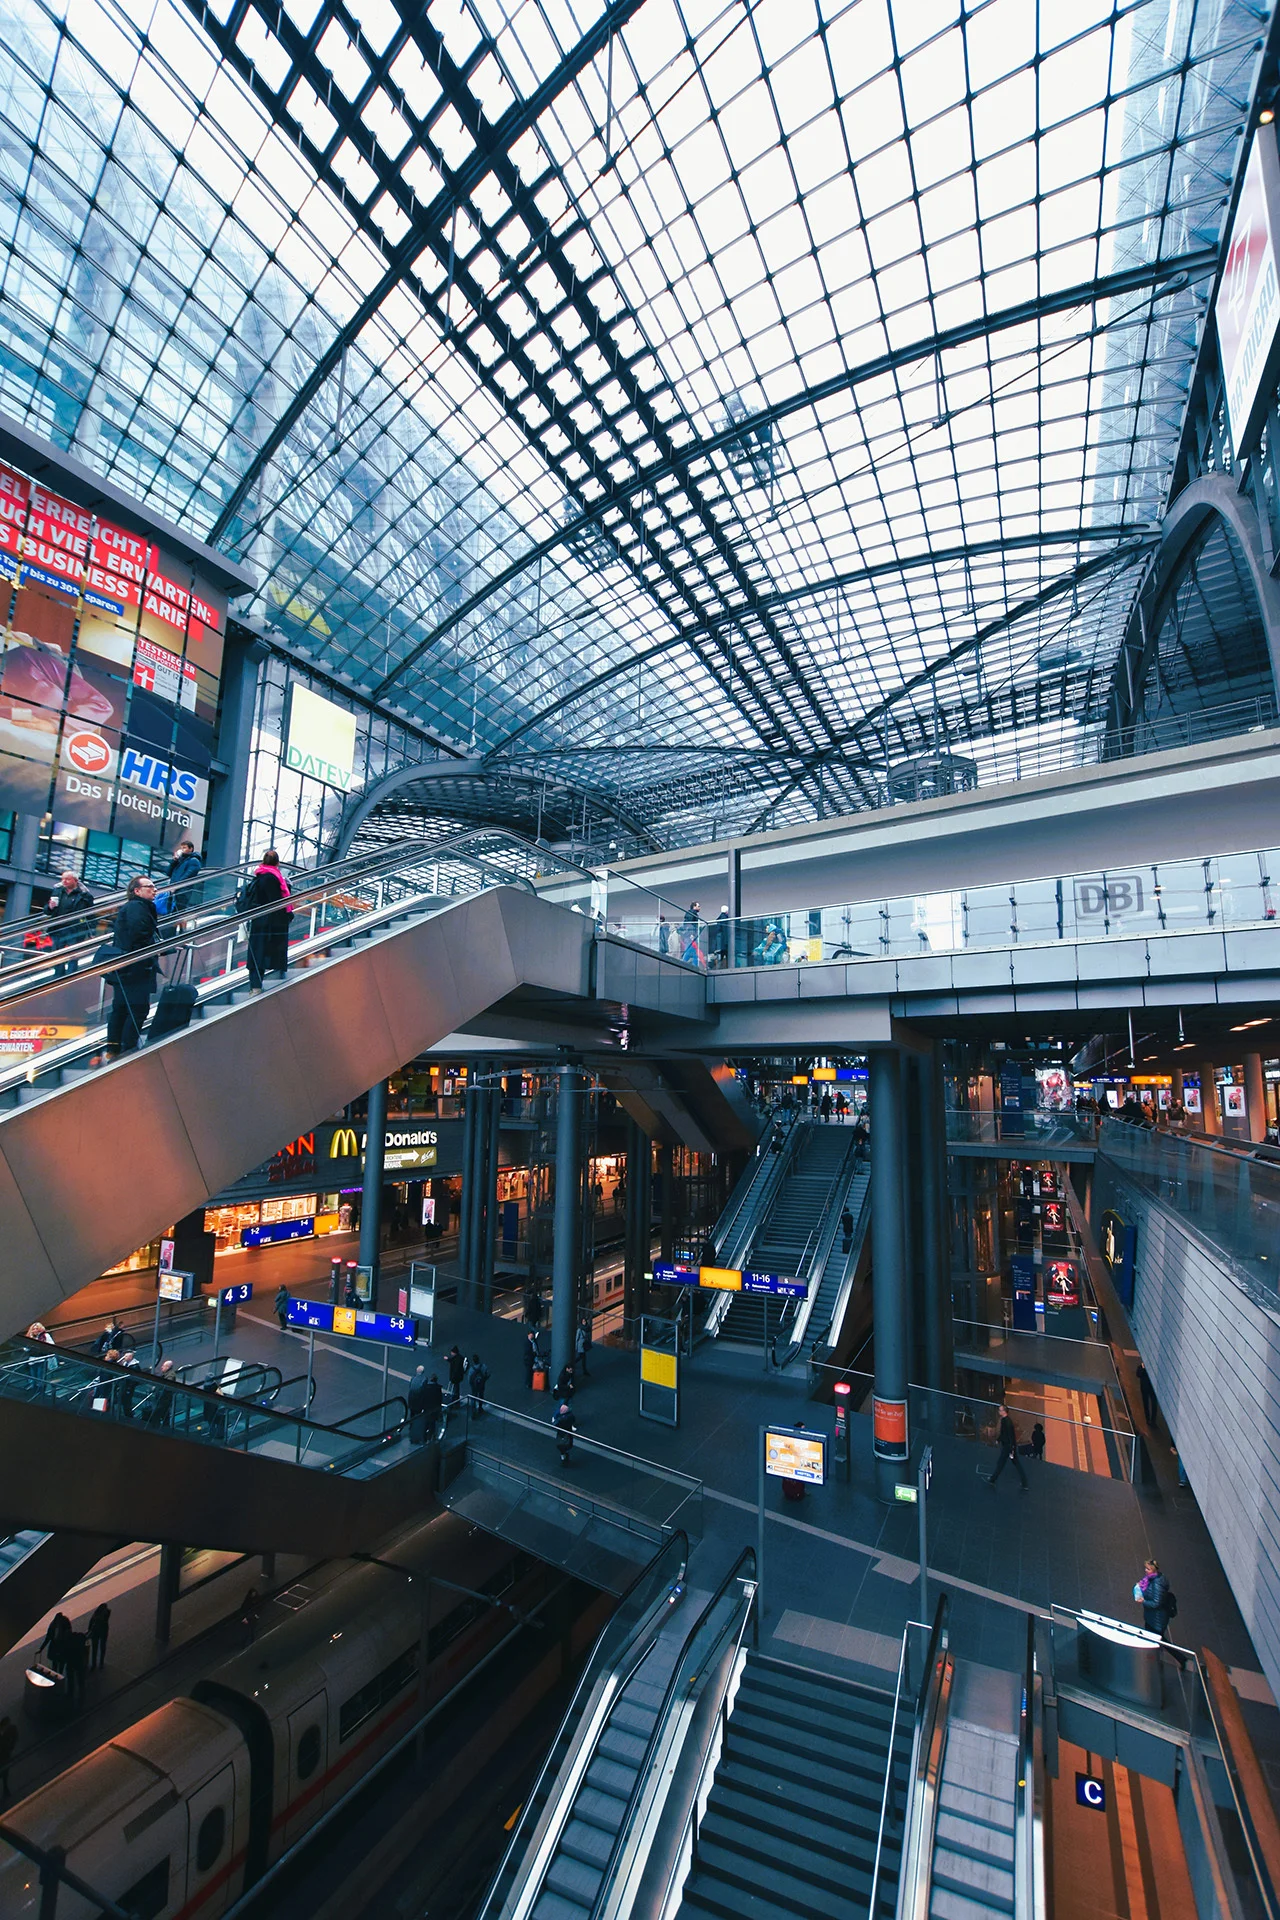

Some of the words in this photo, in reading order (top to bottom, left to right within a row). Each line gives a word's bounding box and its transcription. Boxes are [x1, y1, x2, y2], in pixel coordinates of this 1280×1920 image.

[28, 484, 143, 562] ERREICHT,
[0, 523, 11, 544] S
[16, 533, 129, 598] BUSINESS
[134, 587, 187, 631] TARIF.
[30, 567, 46, 582] bis
[46, 576, 59, 587] zu
[60, 581, 81, 598] 30%
[84, 593, 120, 614] sparen.
[50, 524, 101, 564] VIEL
[107, 552, 212, 624] ERWARTEN:
[139, 639, 196, 675] TESTSIEGER
[156, 664, 172, 676] GUT
[121, 750, 198, 802] HRS
[287, 745, 351, 789] DATEV
[65, 775, 102, 799] Das
[107, 787, 193, 829] Hotelportal
[1080, 882, 1133, 914] DB
[361, 1130, 438, 1149] Donald's
[225, 1289, 233, 1302] 4
[240, 1285, 248, 1299] 3
[752, 1273, 771, 1284] 11-16
[296, 1301, 308, 1312] 1-4
[390, 1317, 405, 1330] 5-8
[1084, 1780, 1102, 1804] C
